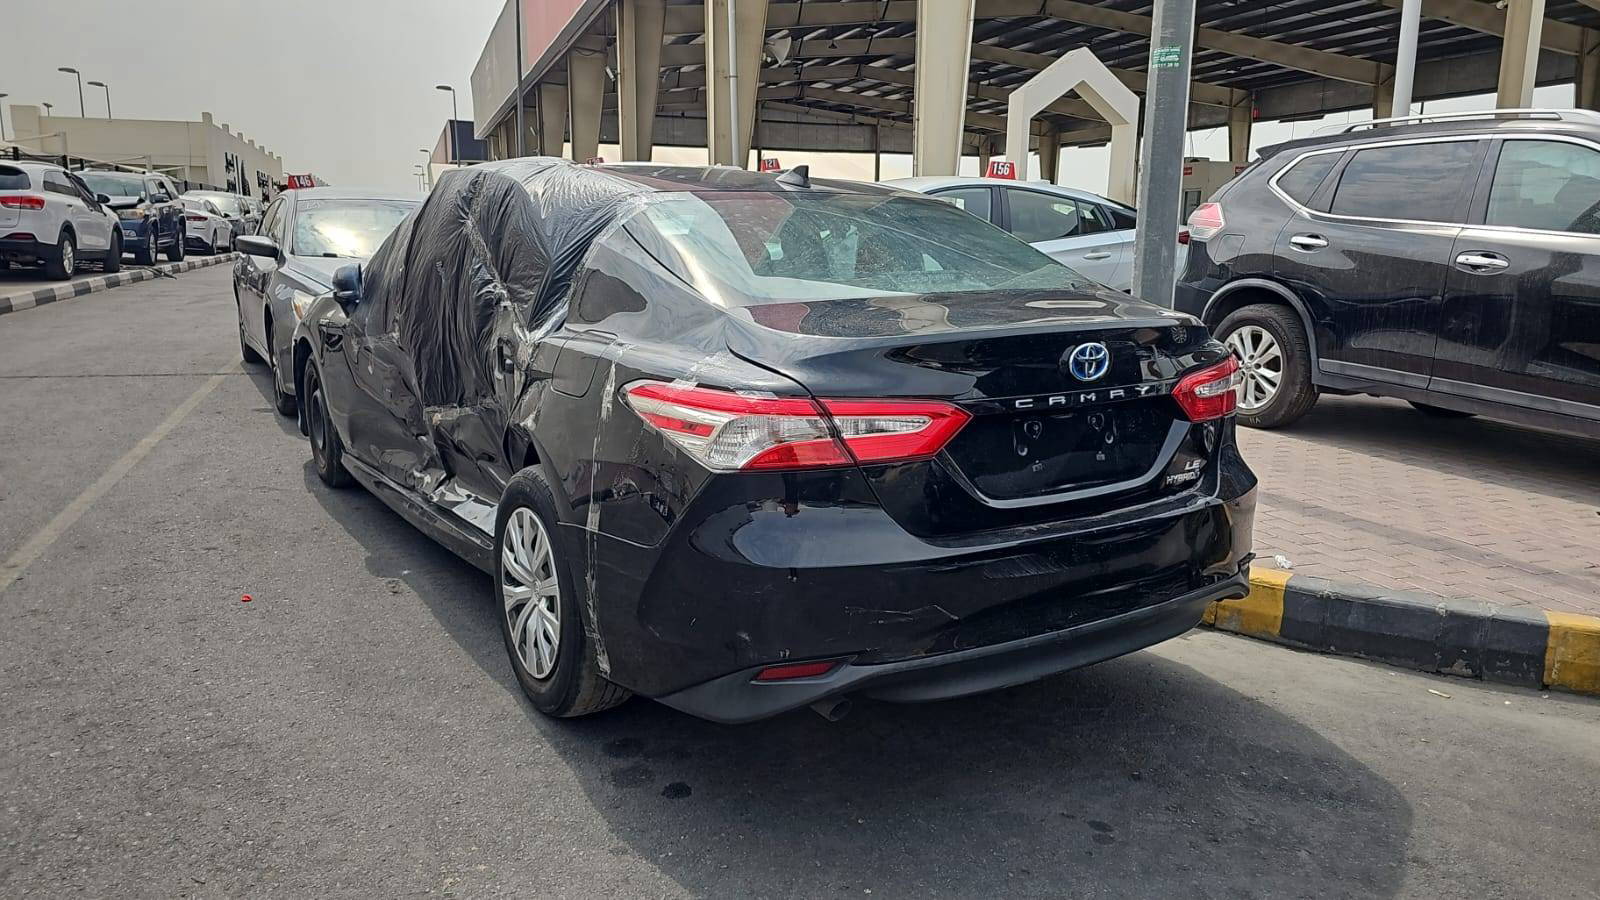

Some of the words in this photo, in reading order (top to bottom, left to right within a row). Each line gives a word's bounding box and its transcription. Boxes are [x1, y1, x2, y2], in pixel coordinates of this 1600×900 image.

[993, 162, 1010, 175] 156
[294, 175, 312, 187] 146
[1015, 386, 1150, 408] CAMRY
[1182, 459, 1201, 470] LE
[1166, 470, 1200, 485] HYBRID
